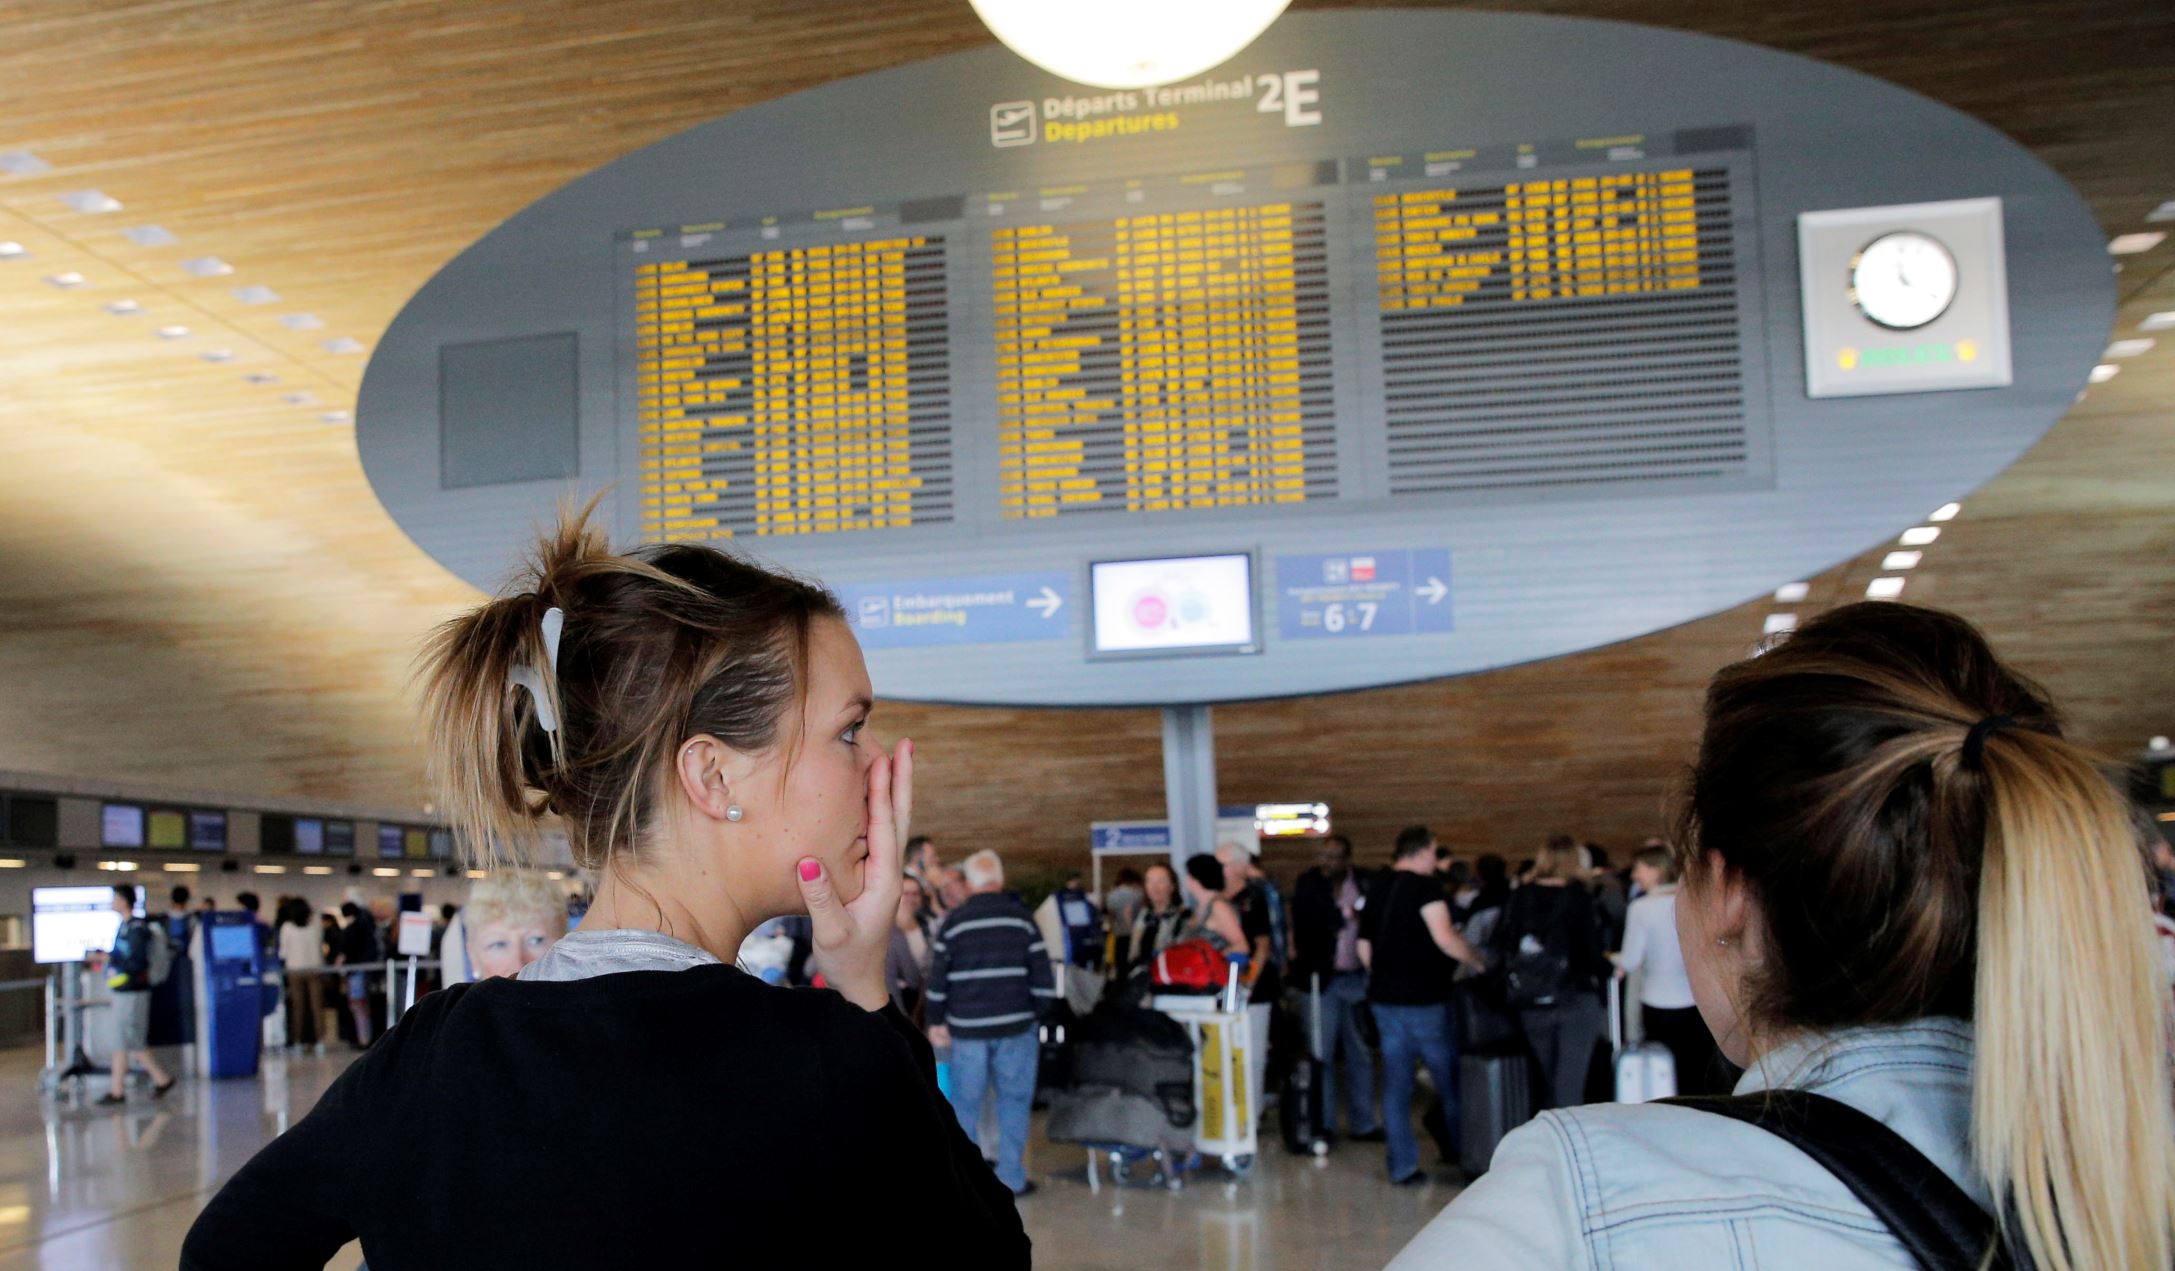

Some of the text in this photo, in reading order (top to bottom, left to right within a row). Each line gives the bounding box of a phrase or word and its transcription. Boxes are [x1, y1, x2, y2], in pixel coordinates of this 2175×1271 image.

[1043, 91, 1138, 120] Départs
[1143, 74, 1253, 107] Terminal
[1045, 111, 1178, 143] Departures
